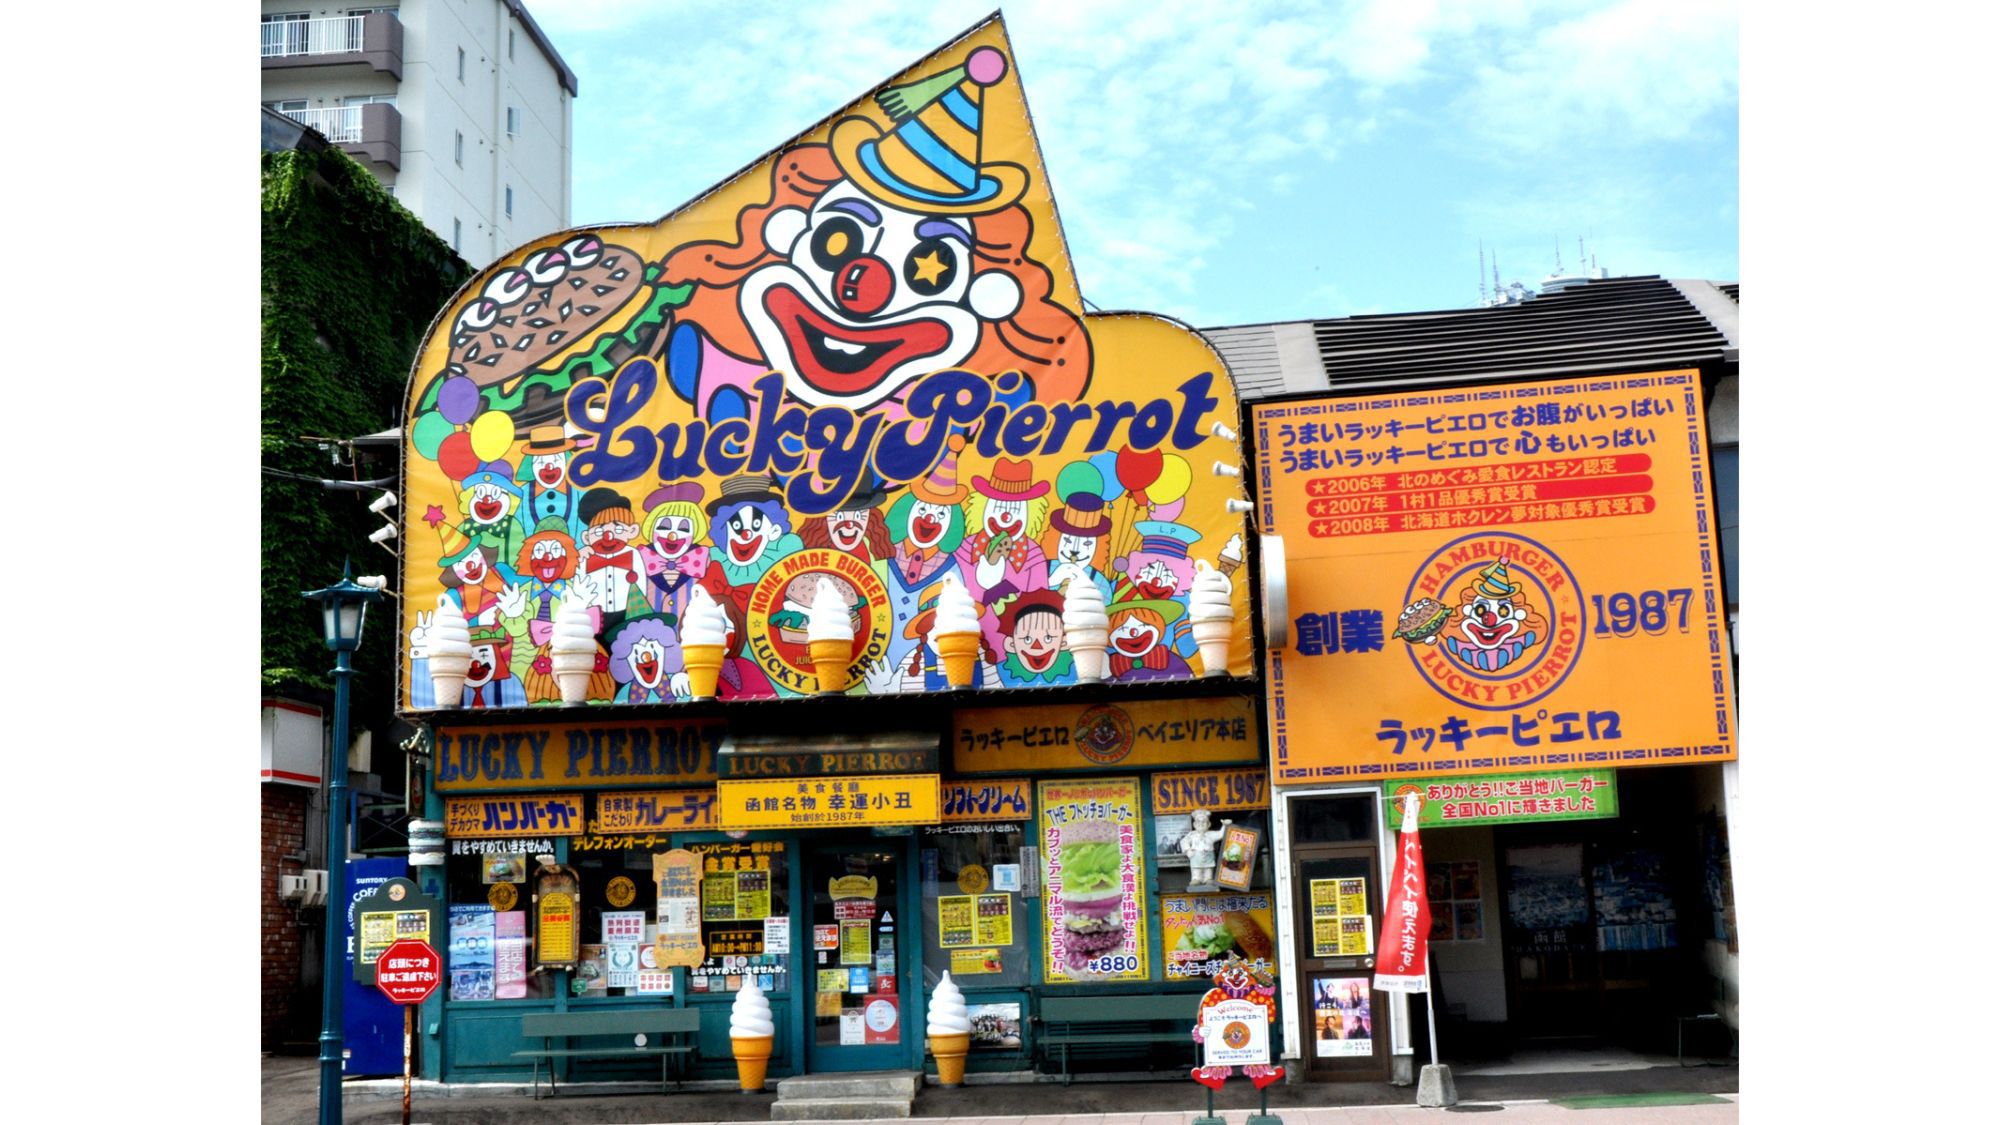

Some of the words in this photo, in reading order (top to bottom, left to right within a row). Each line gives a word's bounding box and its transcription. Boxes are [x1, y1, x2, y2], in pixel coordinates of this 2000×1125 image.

[566, 359, 887, 513] Lucky
[874, 368, 1219, 481] Pierrot
[1277, 397, 1675, 447] うまいラッキーピエロでお腹がいっぱい
[1279, 426, 1657, 474] うまいラッキーピエロで心もいっぱい
[1328, 475, 1387, 496] 2006年
[1397, 457, 1618, 488] 北のめぐみ愛食レストラン認定
[1328, 495, 1388, 515] 2007年
[1400, 484, 1537, 509] 1村1品優秀賞受賞
[1329, 514, 1390, 535] 2008年
[751, 571, 784, 614] HOME
[782, 552, 830, 576] MADE
[836, 554, 887, 608] BURGER
[1420, 540, 1565, 595] HAMBURGER
[1593, 587, 1695, 639] 1987
[1294, 606, 1385, 657] 創業
[752, 633, 808, 689] LUCKY
[1421, 650, 1499, 702] LUCKY
[1506, 611, 1577, 700] PIERROT
[960, 725, 1070, 753] ラッキーピエロ
[1137, 717, 1247, 742] ベイエリア本店
[1376, 709, 1622, 754] ラッキーピエロ
[437, 730, 550, 783] LUCKY
[729, 755, 813, 775] LUCKY
[820, 752, 927, 773] PIERROT
[604, 797, 632, 812] 自家製
[745, 796, 817, 812] 函館名物
[827, 791, 912, 811] 幸運小丑
[1158, 775, 1220, 809] SINCE
[1225, 772, 1268, 804] 1987
[1442, 796, 1595, 819] 全国No1に輝きました
[450, 818, 480, 832] デカウマ
[451, 803, 480, 817] 手づくり
[482, 800, 577, 831] ハンバーガー
[604, 813, 632, 827] こだわり
[635, 794, 718, 826] カレーライ
[1046, 805, 1068, 827] THE
[573, 835, 667, 851] テレフォンオーダー
[1089, 955, 1139, 972] ¥880
